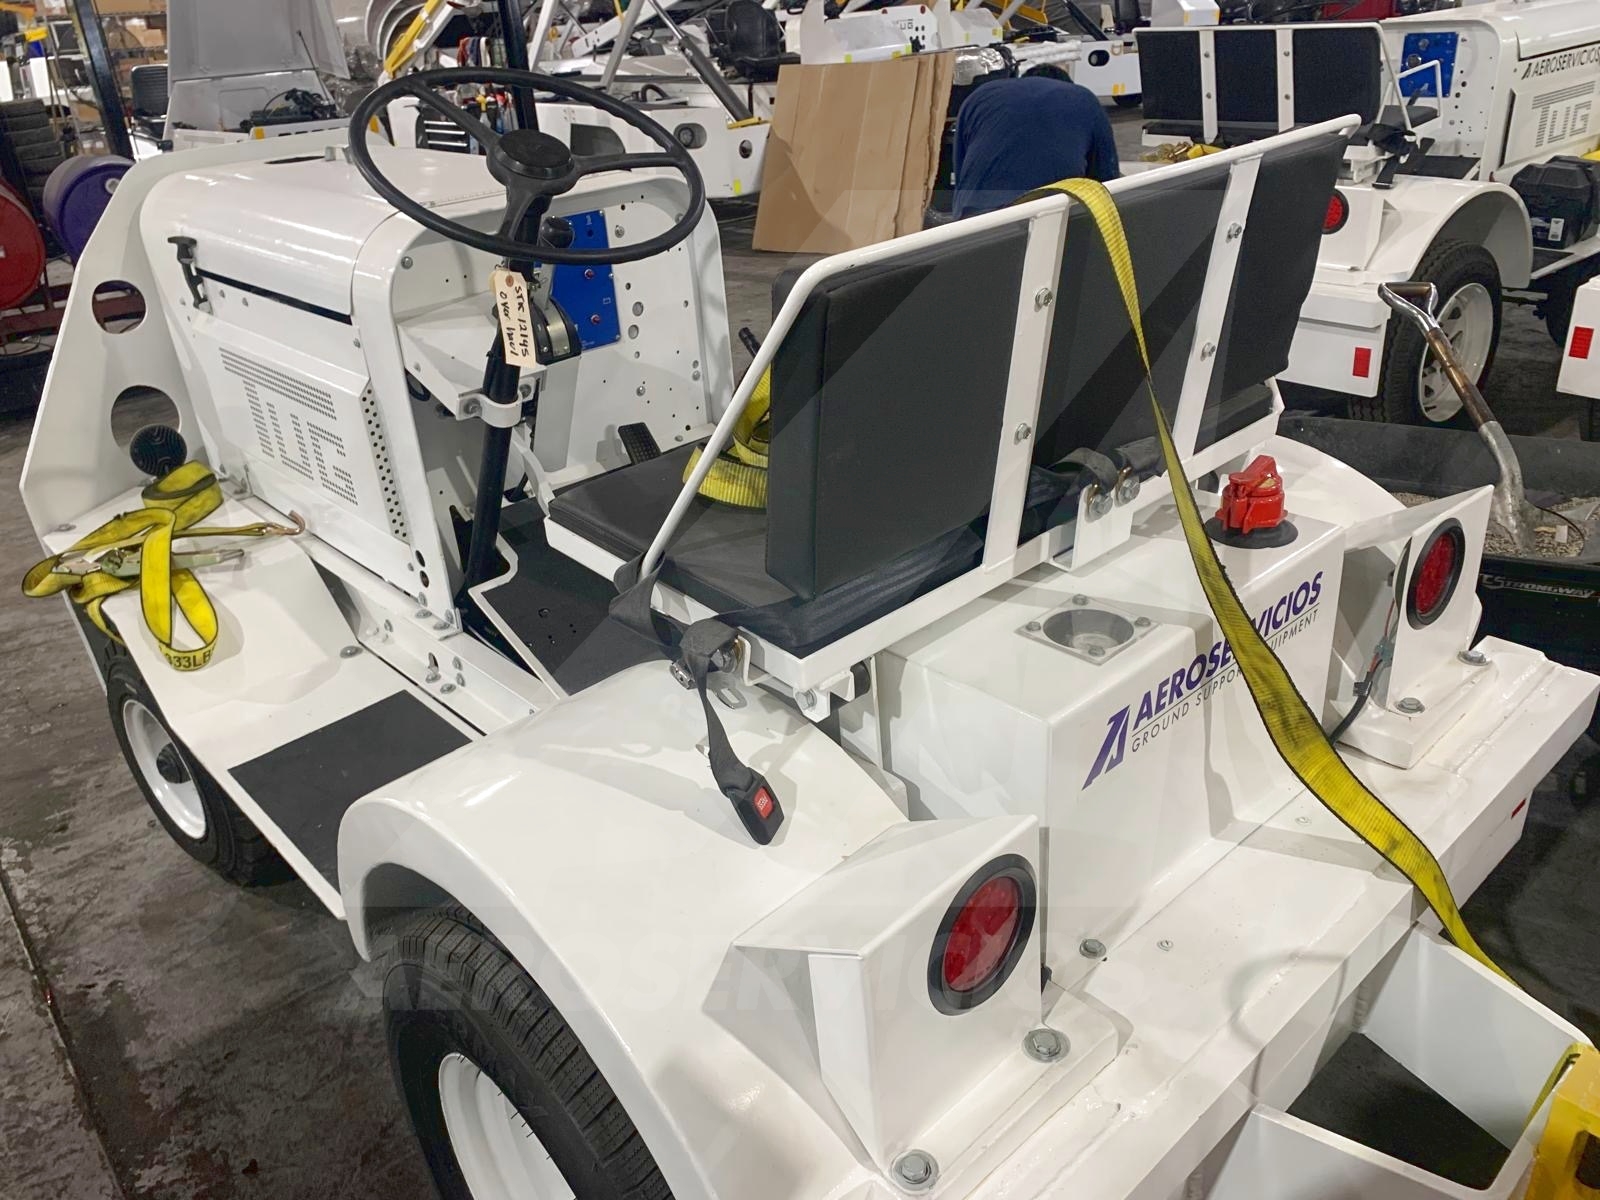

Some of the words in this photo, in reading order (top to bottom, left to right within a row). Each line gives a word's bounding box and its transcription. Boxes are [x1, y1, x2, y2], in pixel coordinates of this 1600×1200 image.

[1531, 80, 1595, 148] TUG
[218, 346, 360, 506] TUG
[1131, 702, 1190, 753] GROUND
[1270, 608, 1319, 651] UIPMENT
[1132, 571, 1323, 731] AEROSEVICIOS
